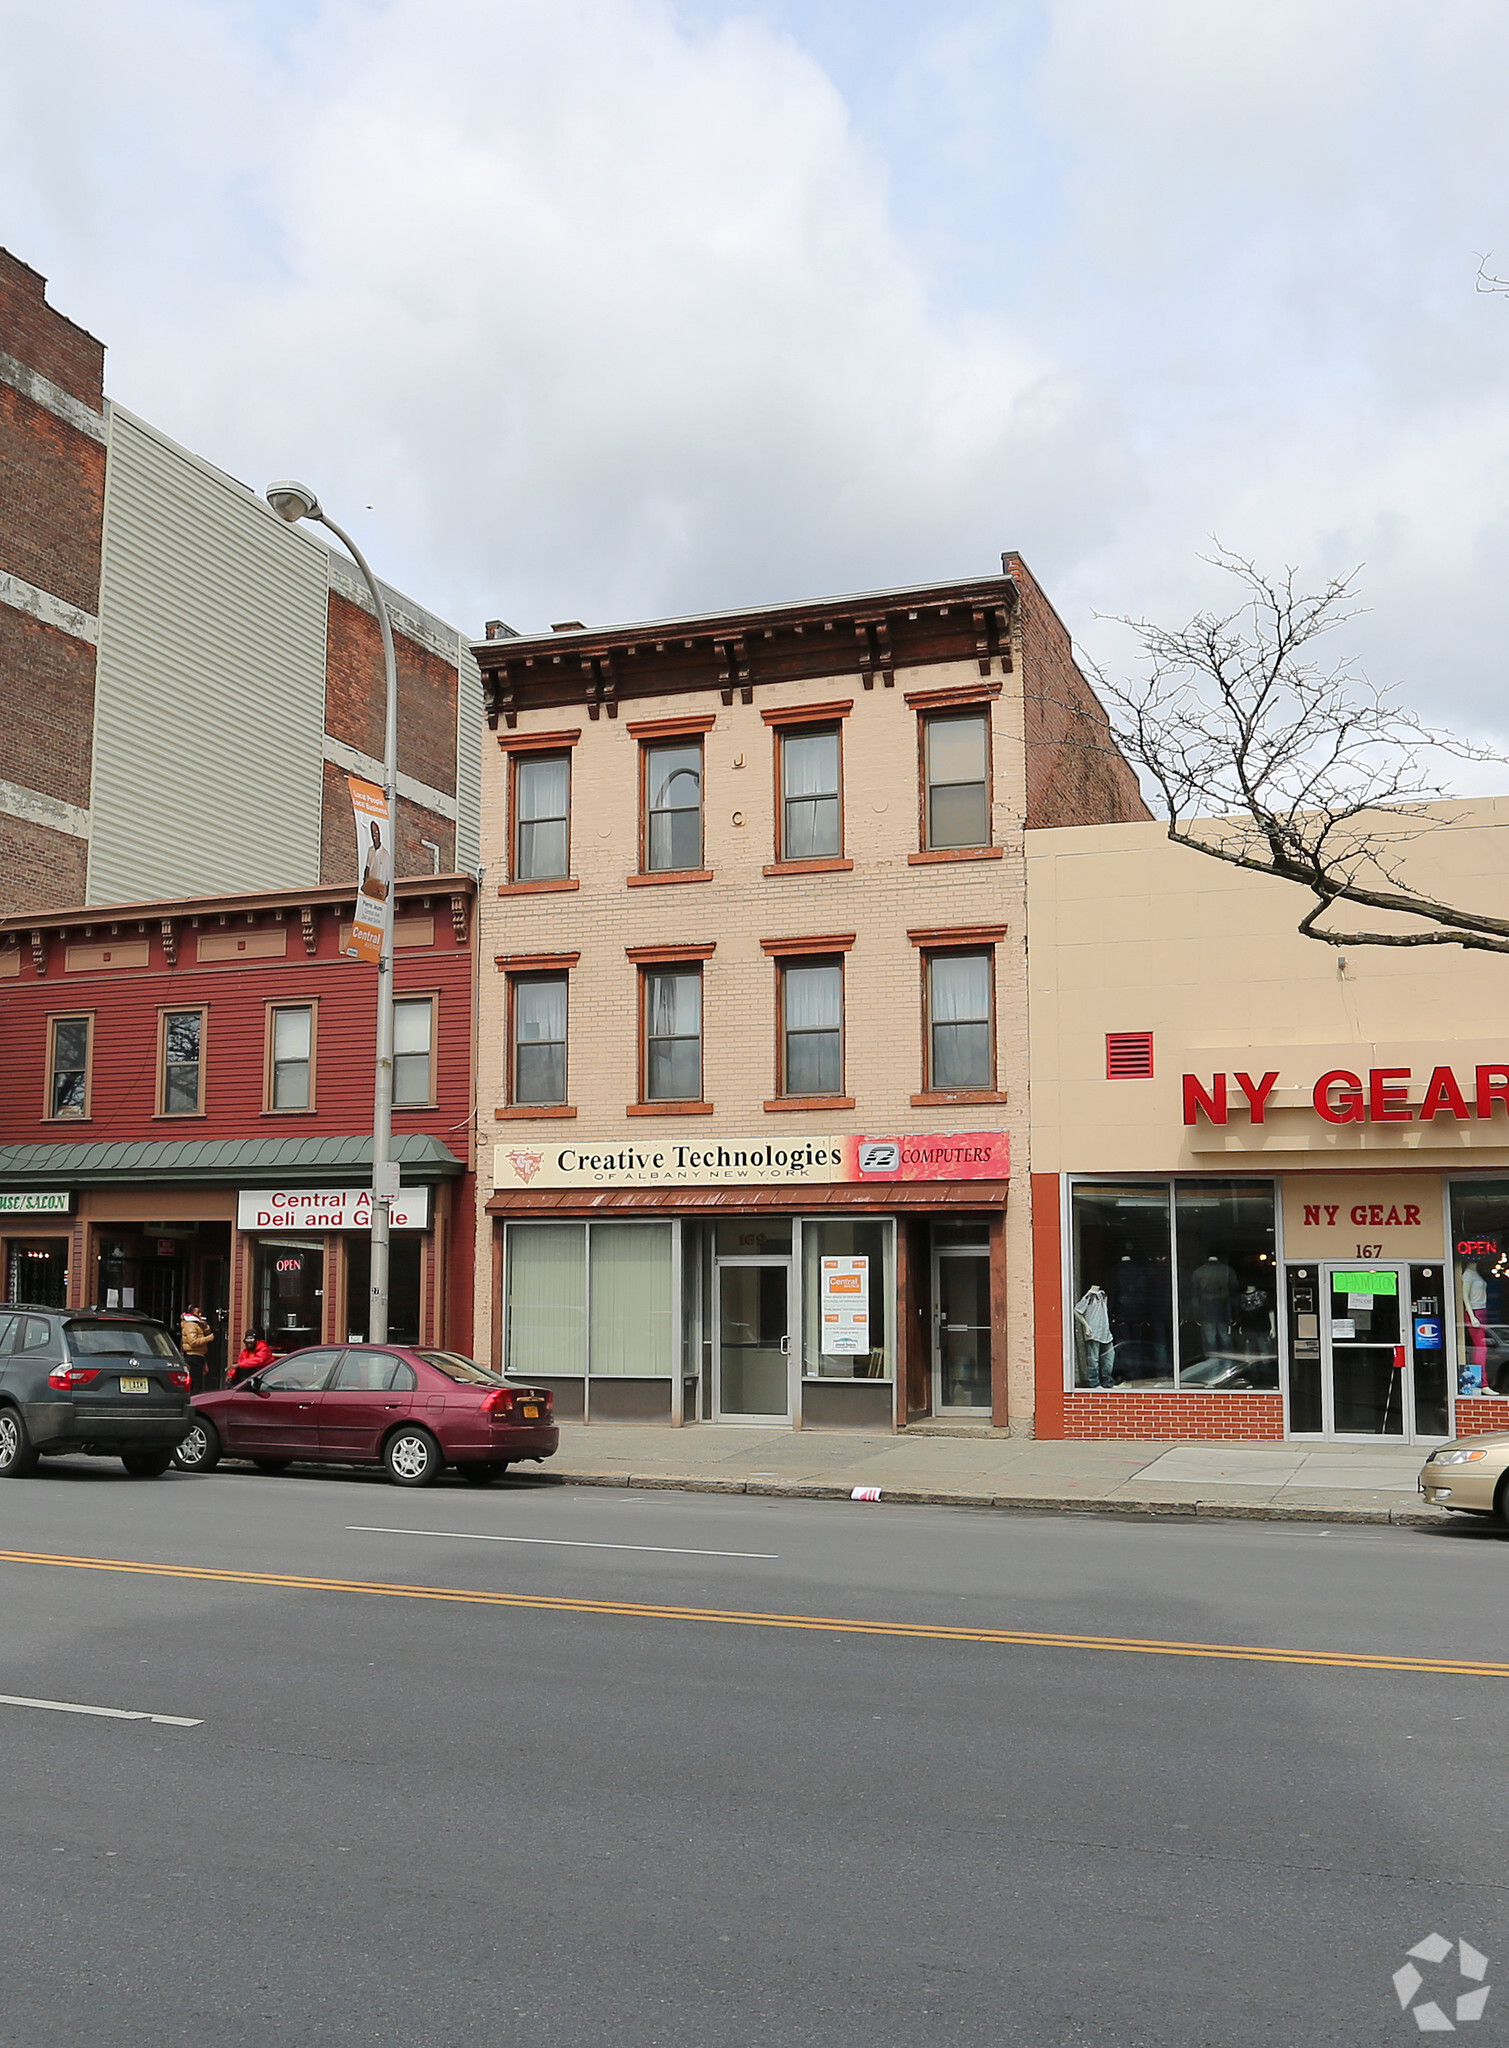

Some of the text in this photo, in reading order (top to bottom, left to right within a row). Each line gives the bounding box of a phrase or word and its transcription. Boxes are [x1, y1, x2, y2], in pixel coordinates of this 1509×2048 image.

[352, 926, 381, 944] Central
[1182, 1064, 1509, 1126] NY GEAR
[557, 1143, 842, 1172] Creative Technologies
[901, 1147, 992, 1164] COMPUTERS
[624, 1171, 701, 1180] ALBANY
[709, 1170, 749, 1178] NEW
[758, 1169, 810, 1177] YORK
[272, 1192, 347, 1208] Central
[257, 1211, 295, 1226] Deli
[305, 1211, 343, 1226] and
[1303, 1204, 1421, 1226] NY GEAR
[739, 1233, 768, 1247] 169
[1356, 1244, 1383, 1258] 167
[1456, 1241, 1498, 1255] OPEN
[276, 1259, 301, 1272] OPEN
[830, 1278, 858, 1286] Central
